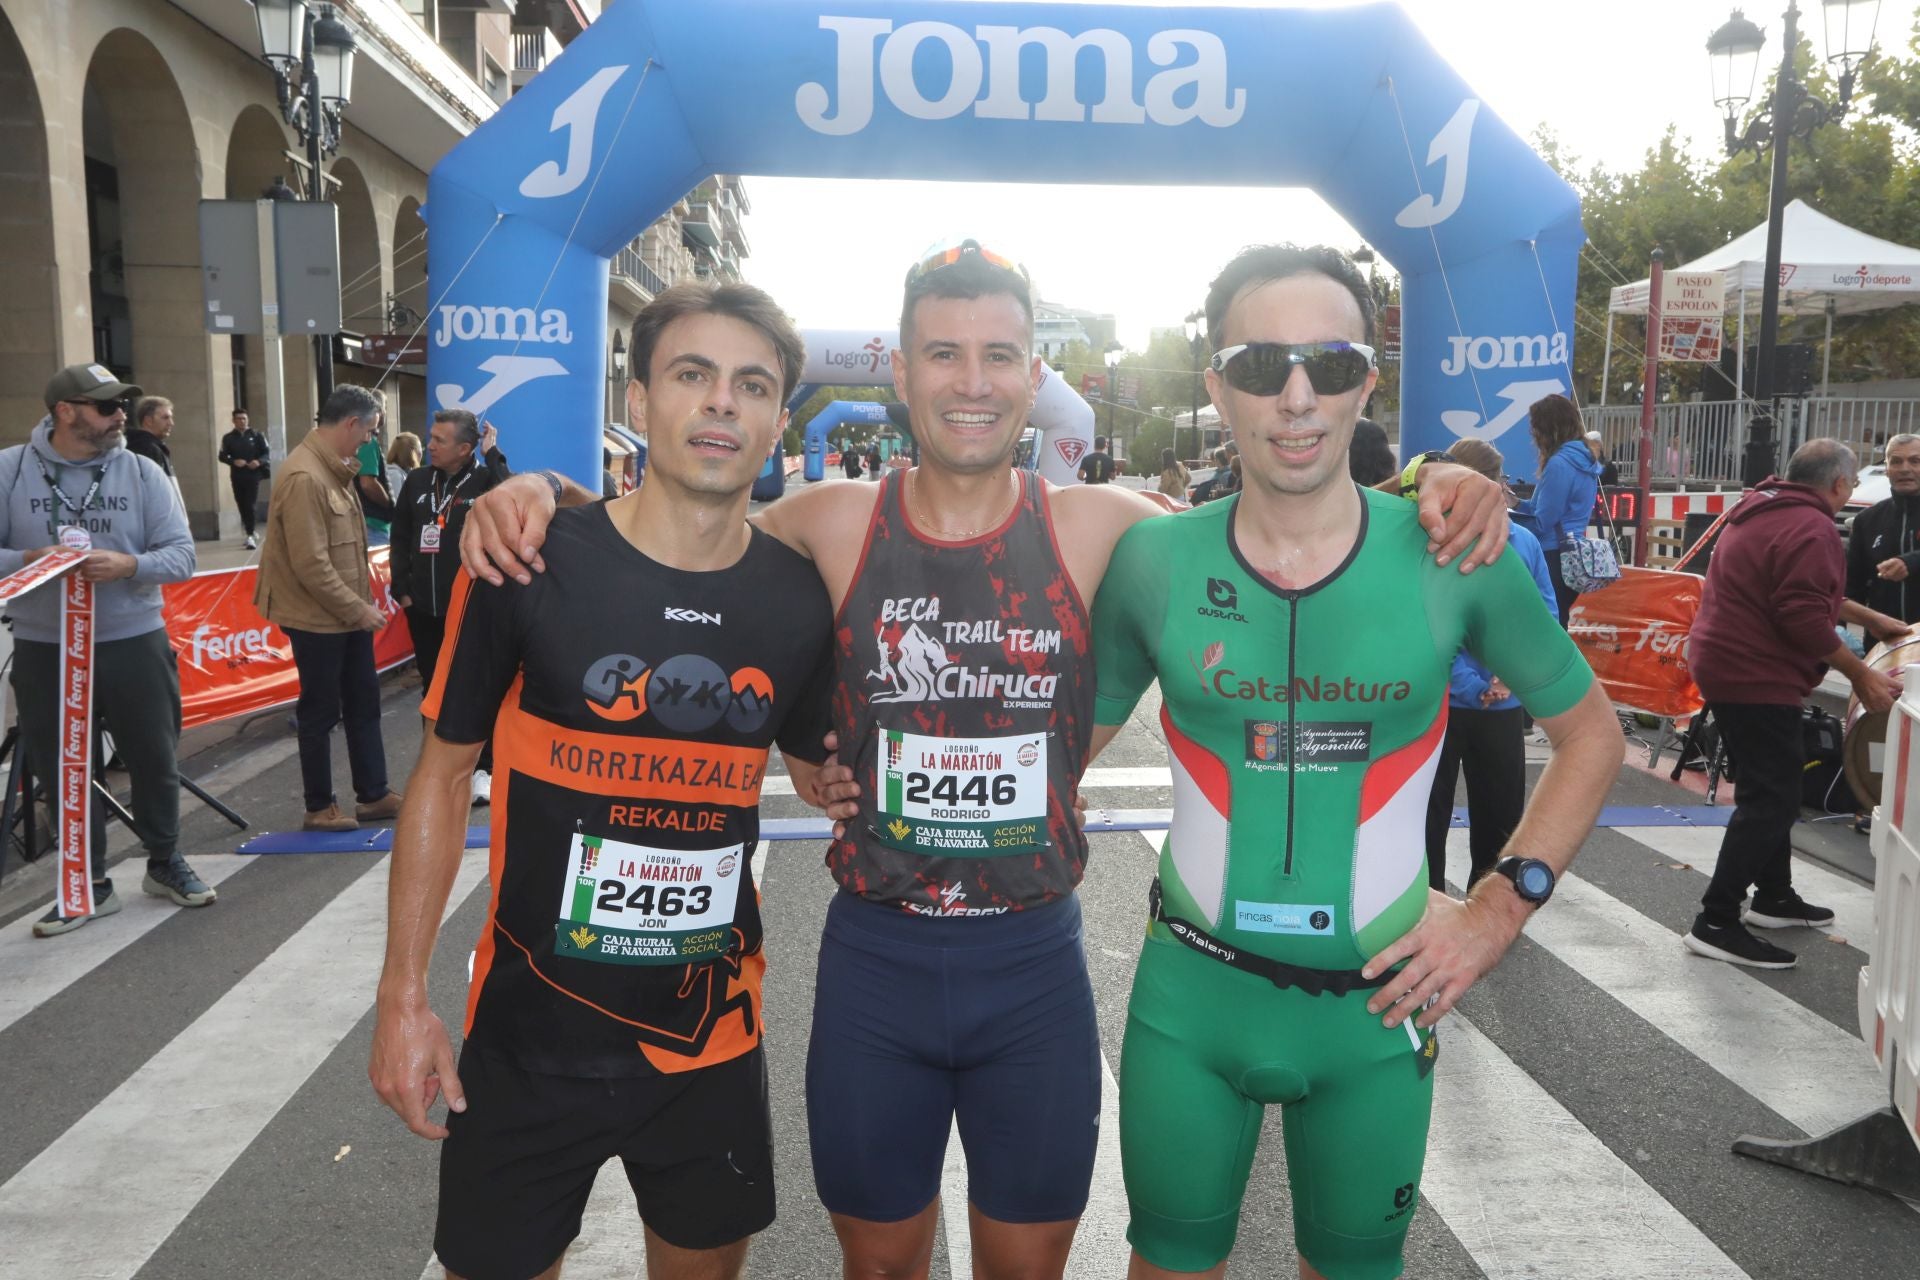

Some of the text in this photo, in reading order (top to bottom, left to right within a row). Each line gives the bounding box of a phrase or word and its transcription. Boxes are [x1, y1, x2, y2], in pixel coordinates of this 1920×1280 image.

[795, 15, 1247, 136] Joma
[1676, 276, 1713, 287] PASEO
[1873, 274, 1912, 286] deporte
[1682, 288, 1705, 299] DEL
[435, 304, 573, 348] Joma
[1440, 331, 1569, 376] Joma
[852, 404, 887, 413] POWER
[881, 597, 940, 623] BECA
[1197, 607, 1249, 624] austral
[942, 620, 1061, 655] TRAIL TEAM
[937, 666, 1059, 699] Chiruca
[1213, 669, 1412, 703] CataNatura
[1003, 700, 1052, 709] EXPERIENCE
[1300, 728, 1366, 740] Ayuntamiento
[944, 744, 979, 754] LOGROÑO
[1299, 738, 1368, 756] Agoncillo
[921, 751, 1002, 771] LA MARATÓN
[1244, 761, 1338, 773] #Agoncillo Se Mueve
[887, 772, 902, 780] 10K
[906, 772, 1017, 807] 2446
[609, 804, 727, 832] REKALDE
[931, 808, 991, 820] RODRIGO
[916, 826, 985, 839] CAJA RURAL
[994, 824, 1036, 837] ACCIÓN
[916, 836, 989, 848] DE NAVARRA
[993, 835, 1036, 848] SOCIAL
[645, 854, 682, 865] LOGROÑO
[618, 860, 703, 882] LA MARATÓN
[578, 877, 594, 887] 10K
[596, 879, 713, 917] 2463
[638, 918, 668, 929] JON
[1238, 911, 1273, 923] Fincas
[602, 934, 674, 947] CAJA RURAL
[682, 931, 723, 945] ACCIÓN
[600, 944, 678, 957] DE NAVARRA
[681, 942, 720, 956] SOCIAL
[1186, 929, 1236, 961] Kalenji
